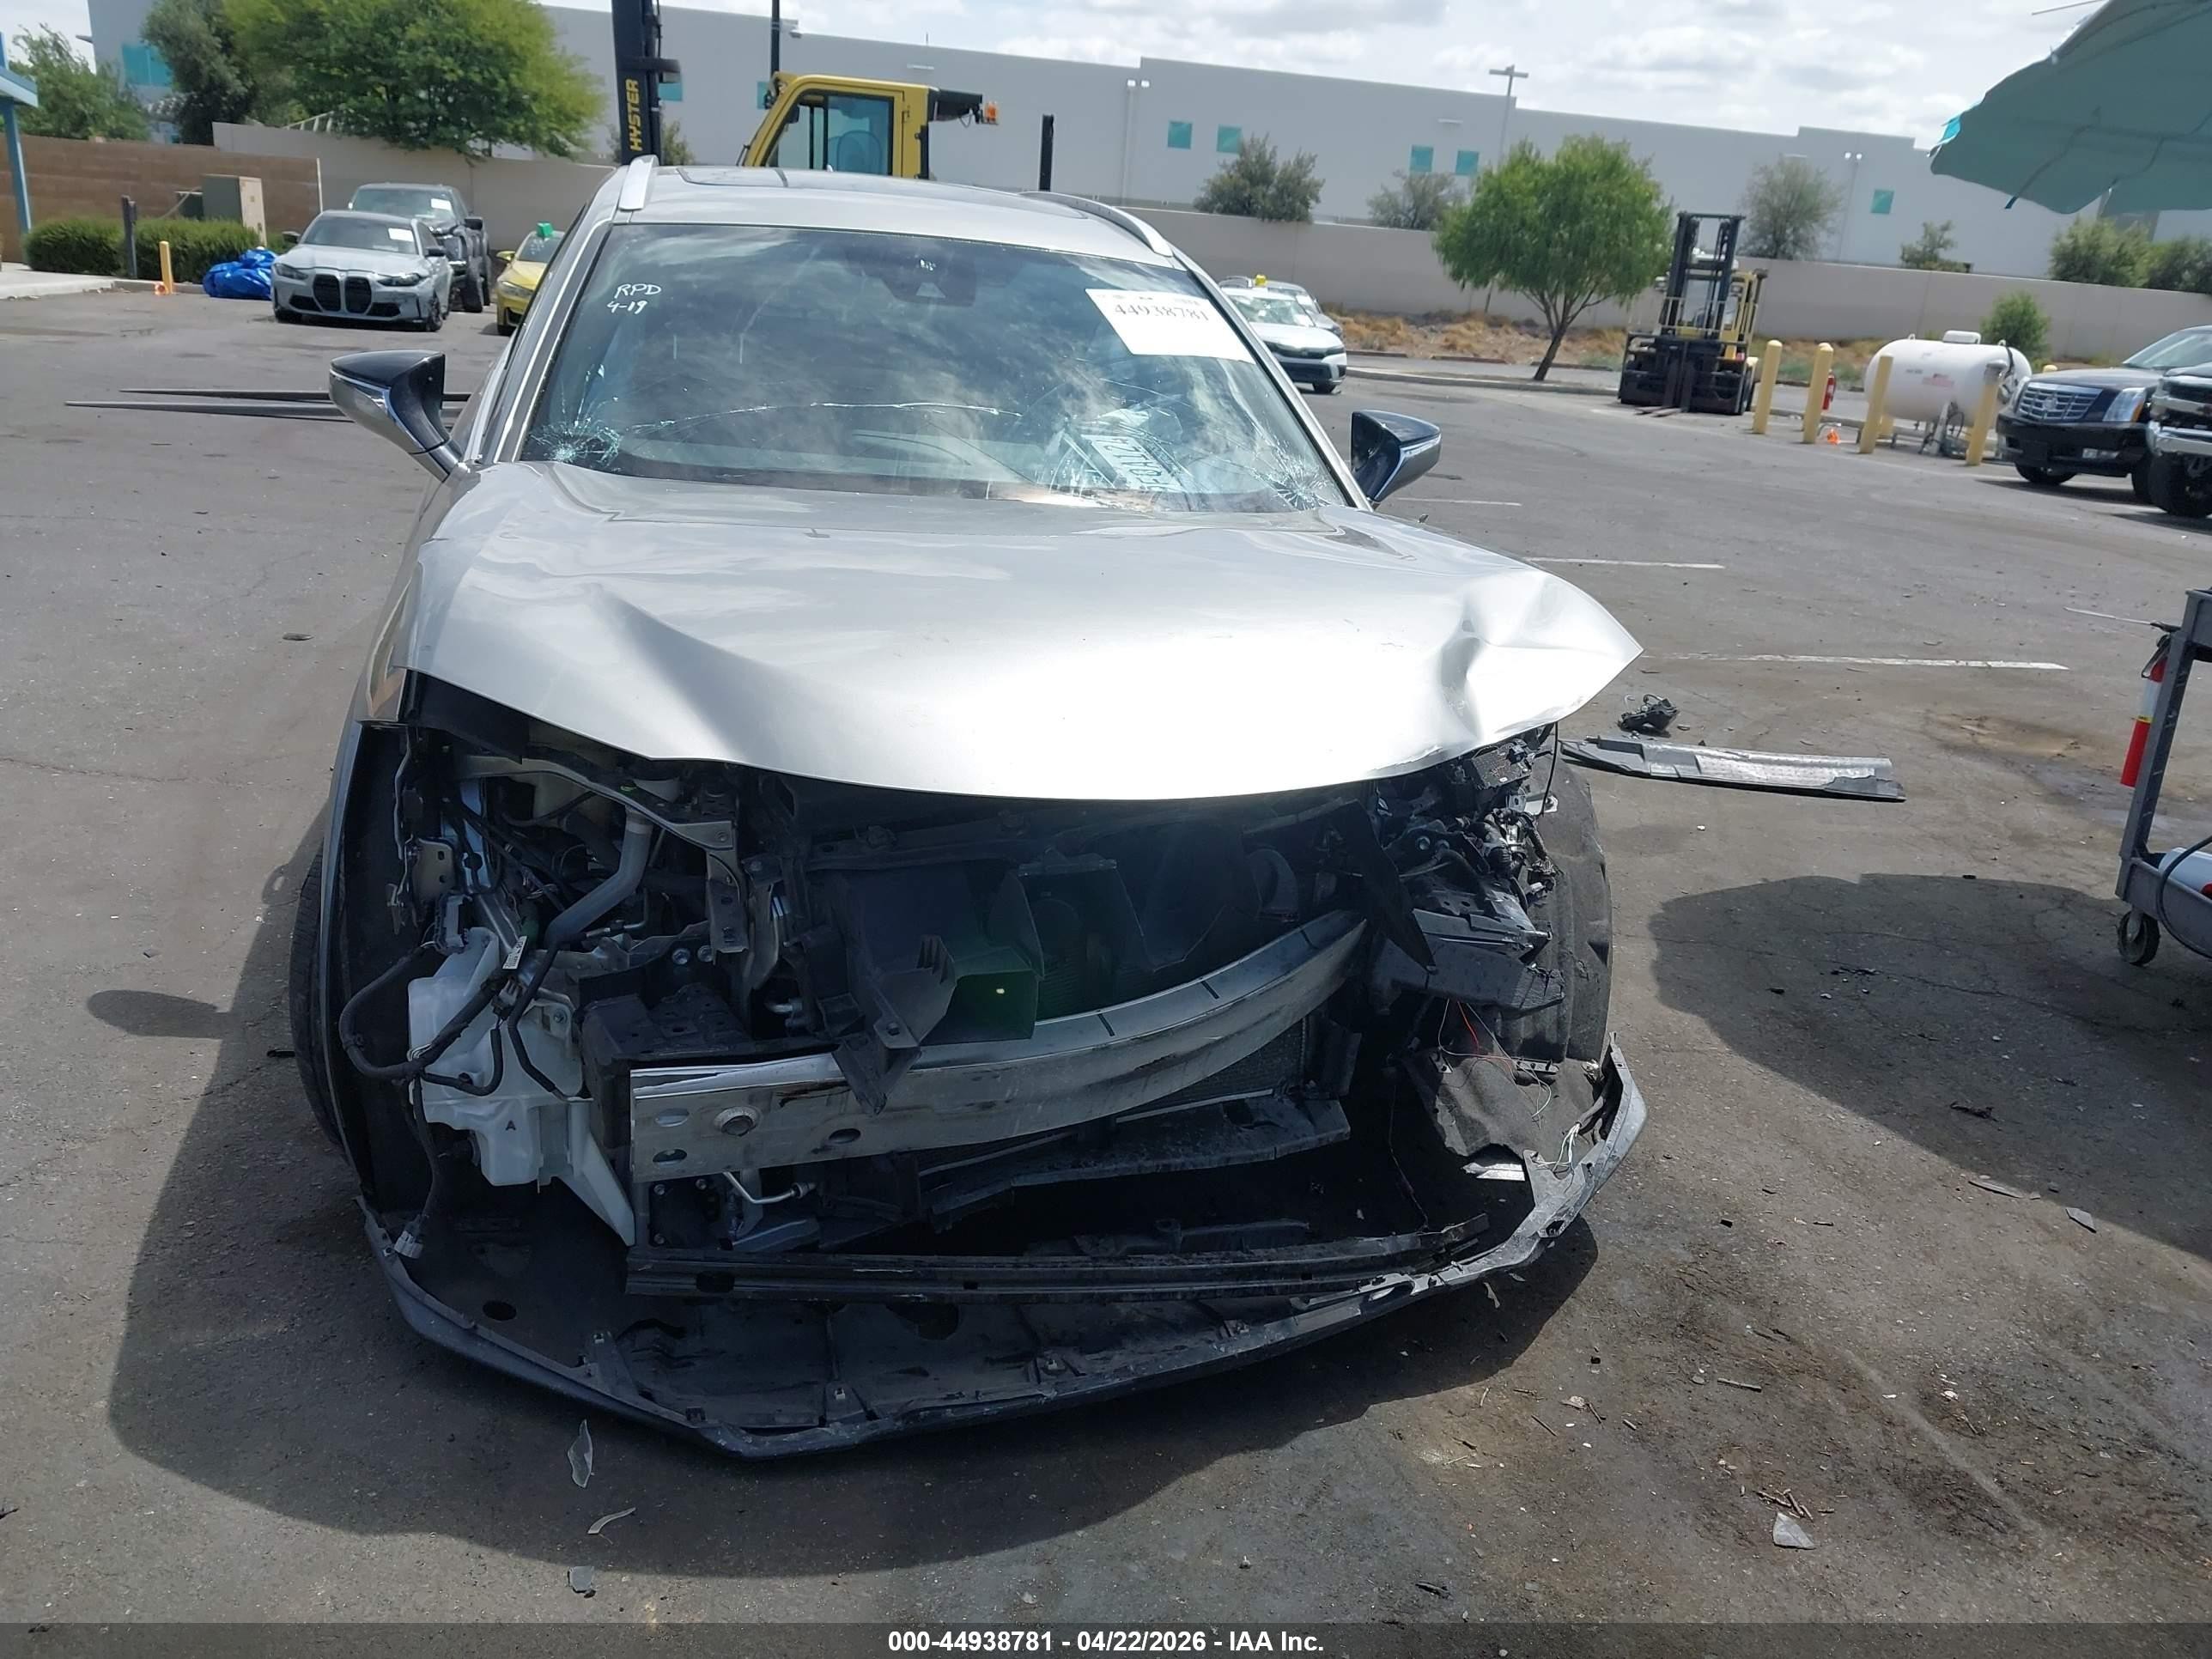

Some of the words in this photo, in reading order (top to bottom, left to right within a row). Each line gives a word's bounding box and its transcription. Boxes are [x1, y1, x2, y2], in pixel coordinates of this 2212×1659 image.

[625, 78, 642, 151] HYSTER
[614, 283, 661, 299] RPD
[606, 301, 648, 314] 4-19
[505, 1120, 517, 1131] A
